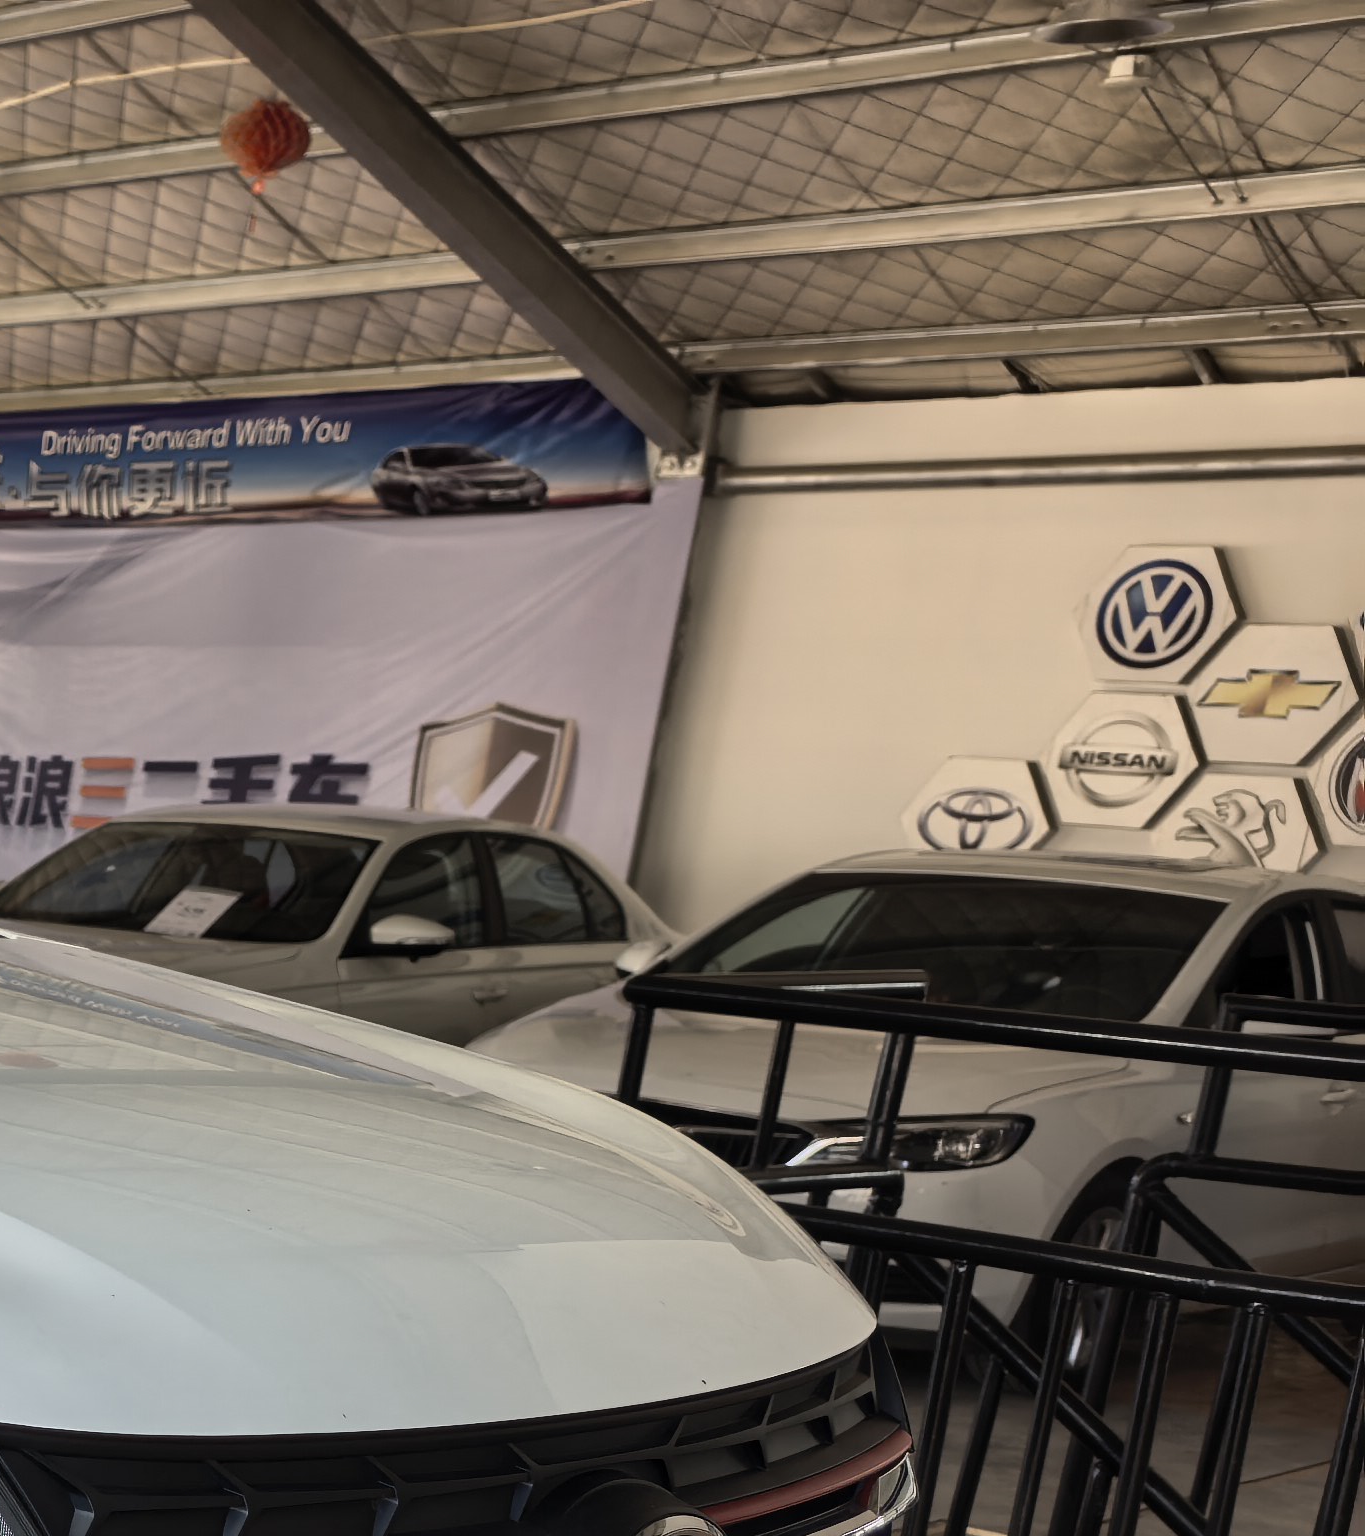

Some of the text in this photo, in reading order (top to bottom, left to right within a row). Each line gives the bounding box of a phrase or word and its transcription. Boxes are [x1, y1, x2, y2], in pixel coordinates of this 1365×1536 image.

[41, 415, 352, 459] Driving Forward With You
[1069, 749, 1167, 770] NISSAN
